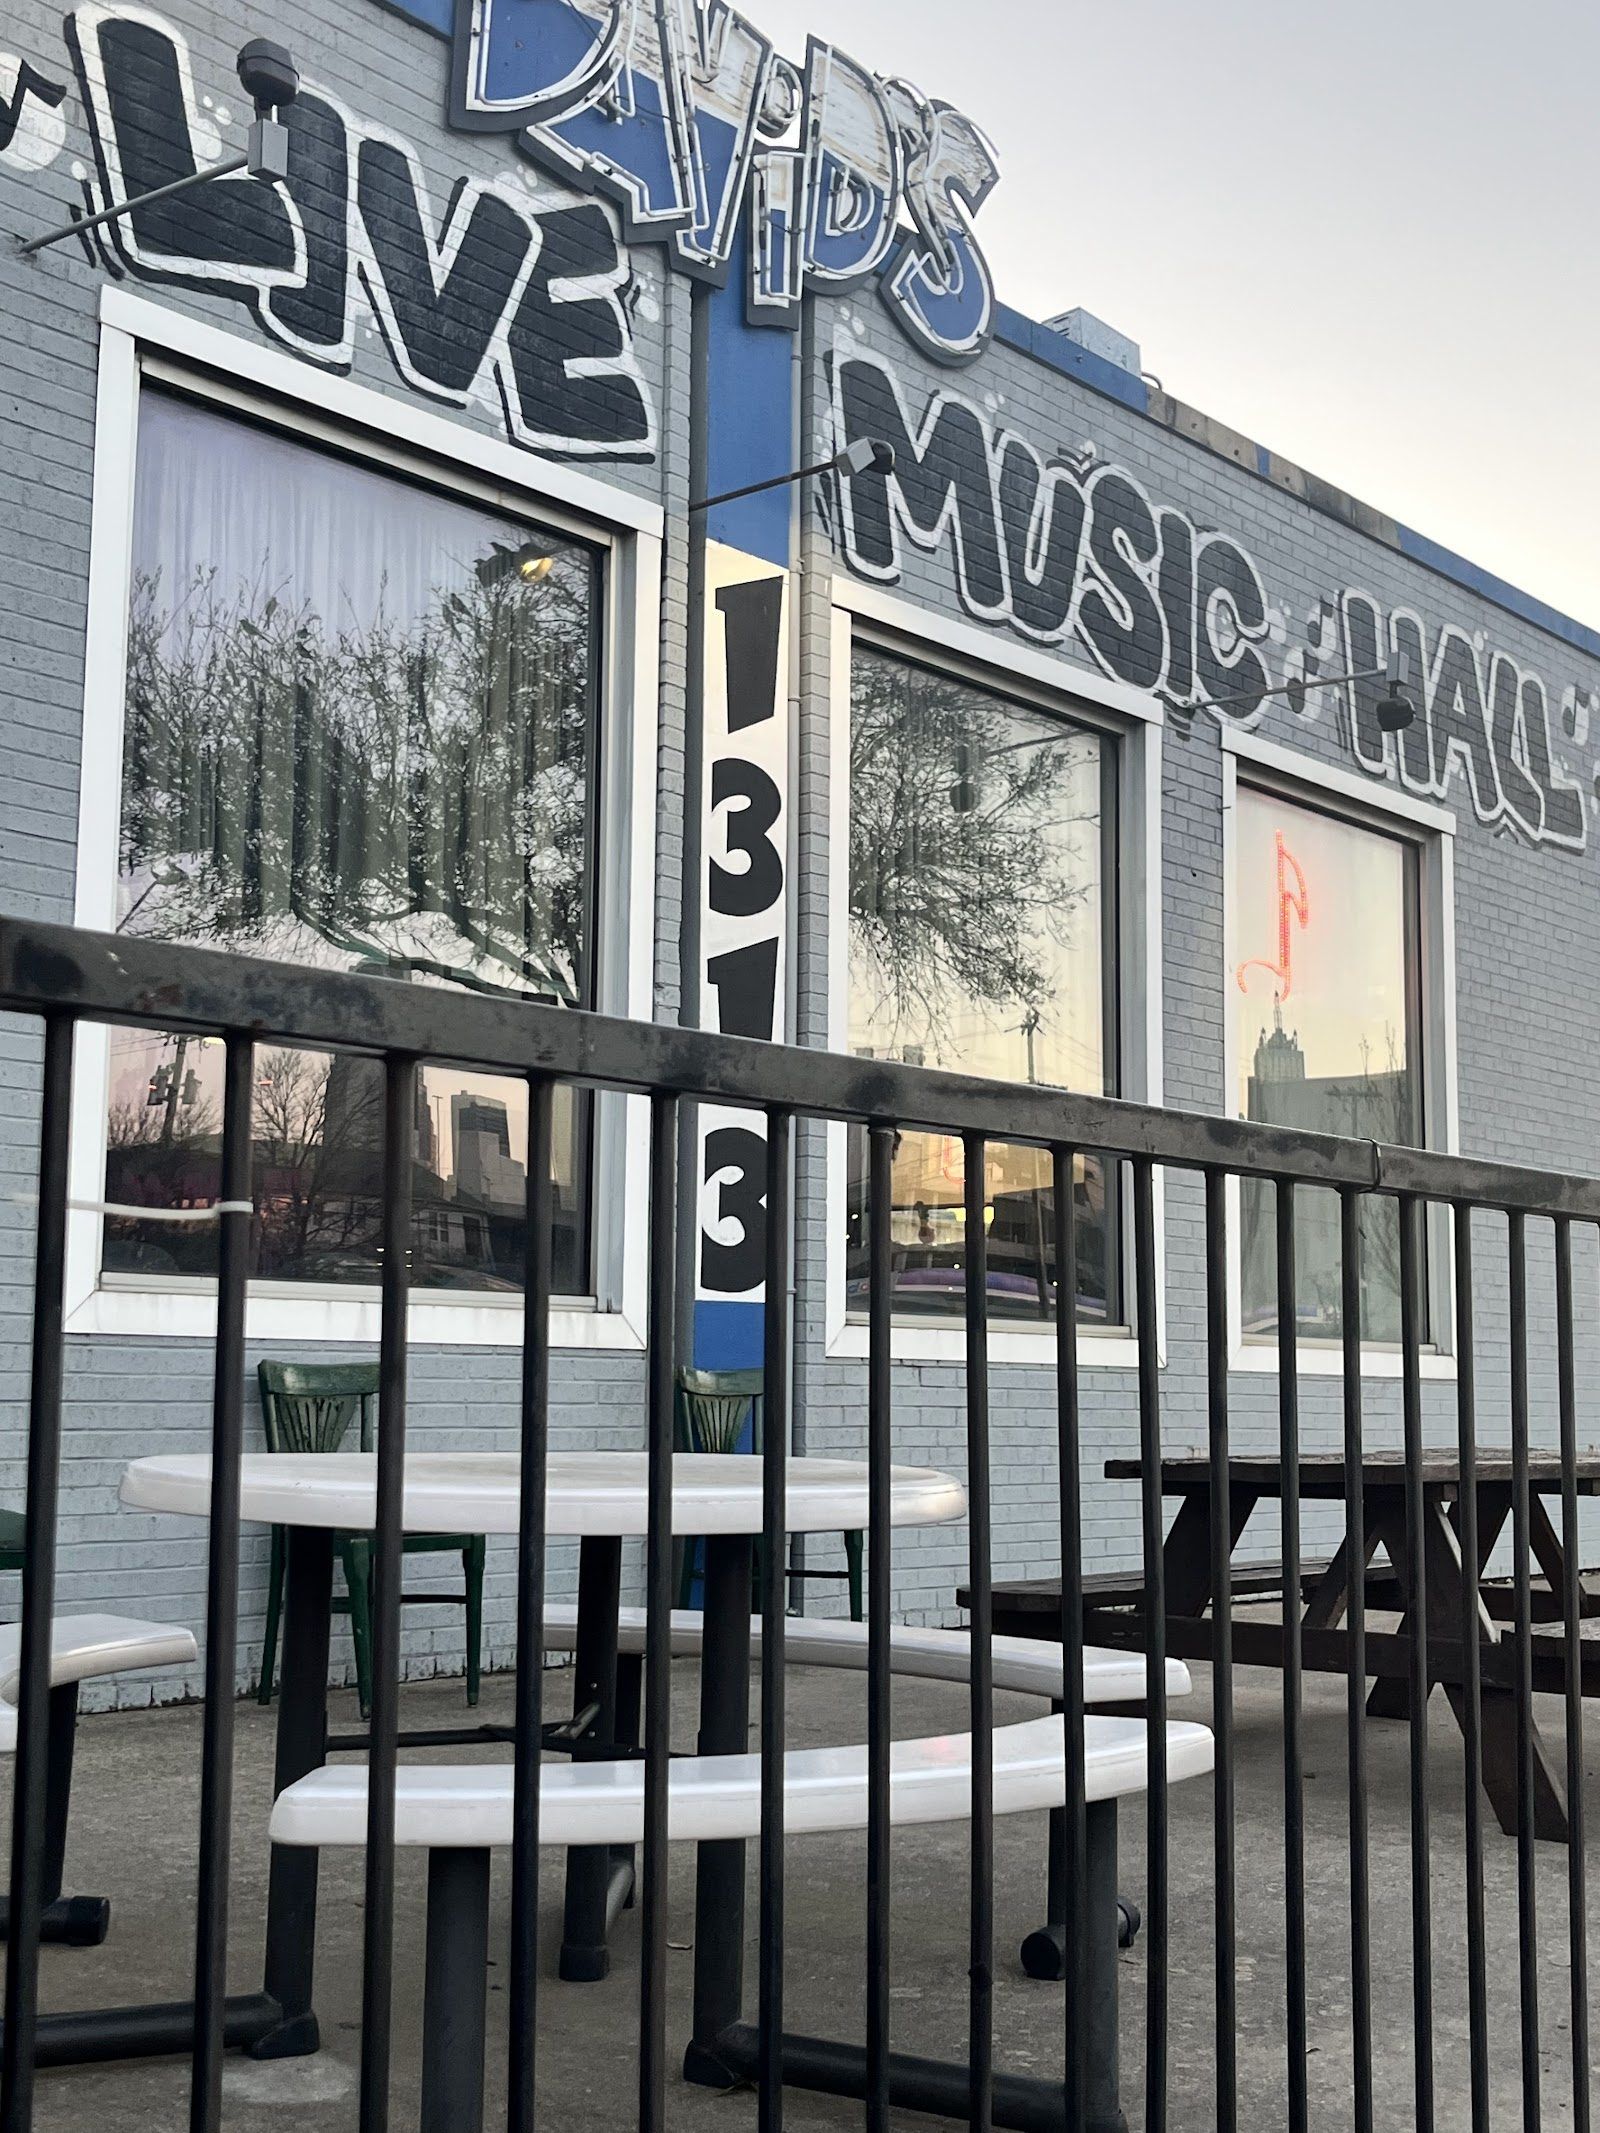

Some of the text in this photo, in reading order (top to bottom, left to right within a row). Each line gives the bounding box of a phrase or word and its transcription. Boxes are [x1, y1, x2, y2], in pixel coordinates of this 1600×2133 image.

[66, 5, 1589, 856] LIVE MUSIC HALL
[700, 574, 784, 1294] 1313
